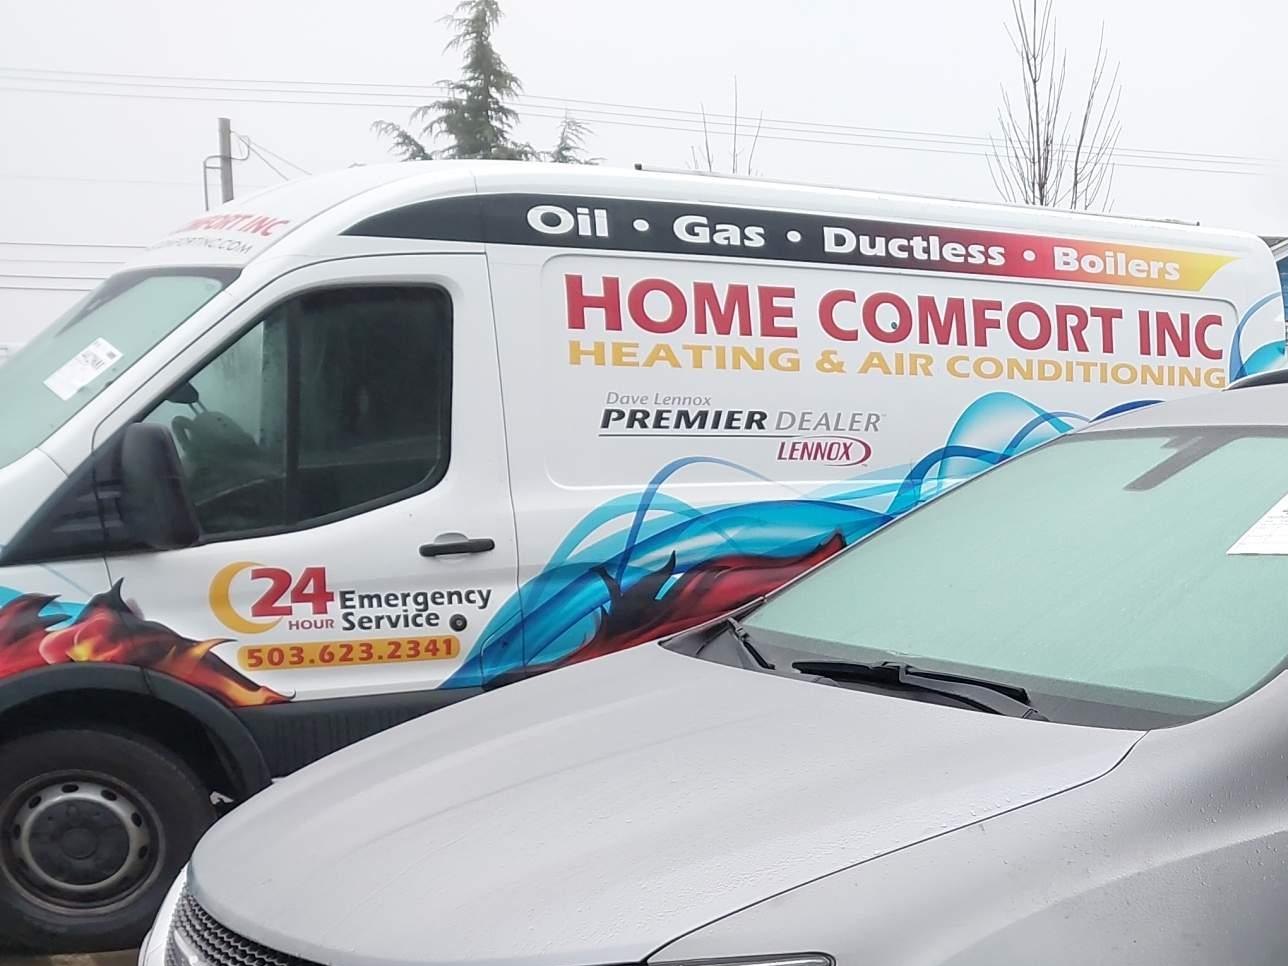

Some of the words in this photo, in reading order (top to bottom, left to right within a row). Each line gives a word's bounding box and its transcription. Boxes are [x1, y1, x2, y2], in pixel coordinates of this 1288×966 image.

[526, 204, 609, 237] Oil
[672, 215, 766, 247] Gas
[822, 226, 1006, 265] Ductless
[1053, 246, 1180, 281] Boilers
[564, 273, 798, 338] HOME
[818, 289, 1122, 354] COMFORT
[1139, 309, 1224, 360] INC
[568, 340, 800, 372] HEATING
[815, 349, 847, 374] &
[857, 350, 933, 376] AIR
[946, 355, 1226, 389] CONDITIONING
[606, 391, 649, 405] Dave
[653, 392, 711, 406] Lennox
[600, 408, 768, 430] PREMIER
[775, 411, 881, 432] DEALER
[777, 441, 854, 461] LENNOX
[250, 567, 334, 617] 24
[339, 588, 492, 613] Emergency
[288, 618, 335, 631] HOUR
[342, 610, 440, 632] Service
[247, 637, 453, 668] 503.623.2341
